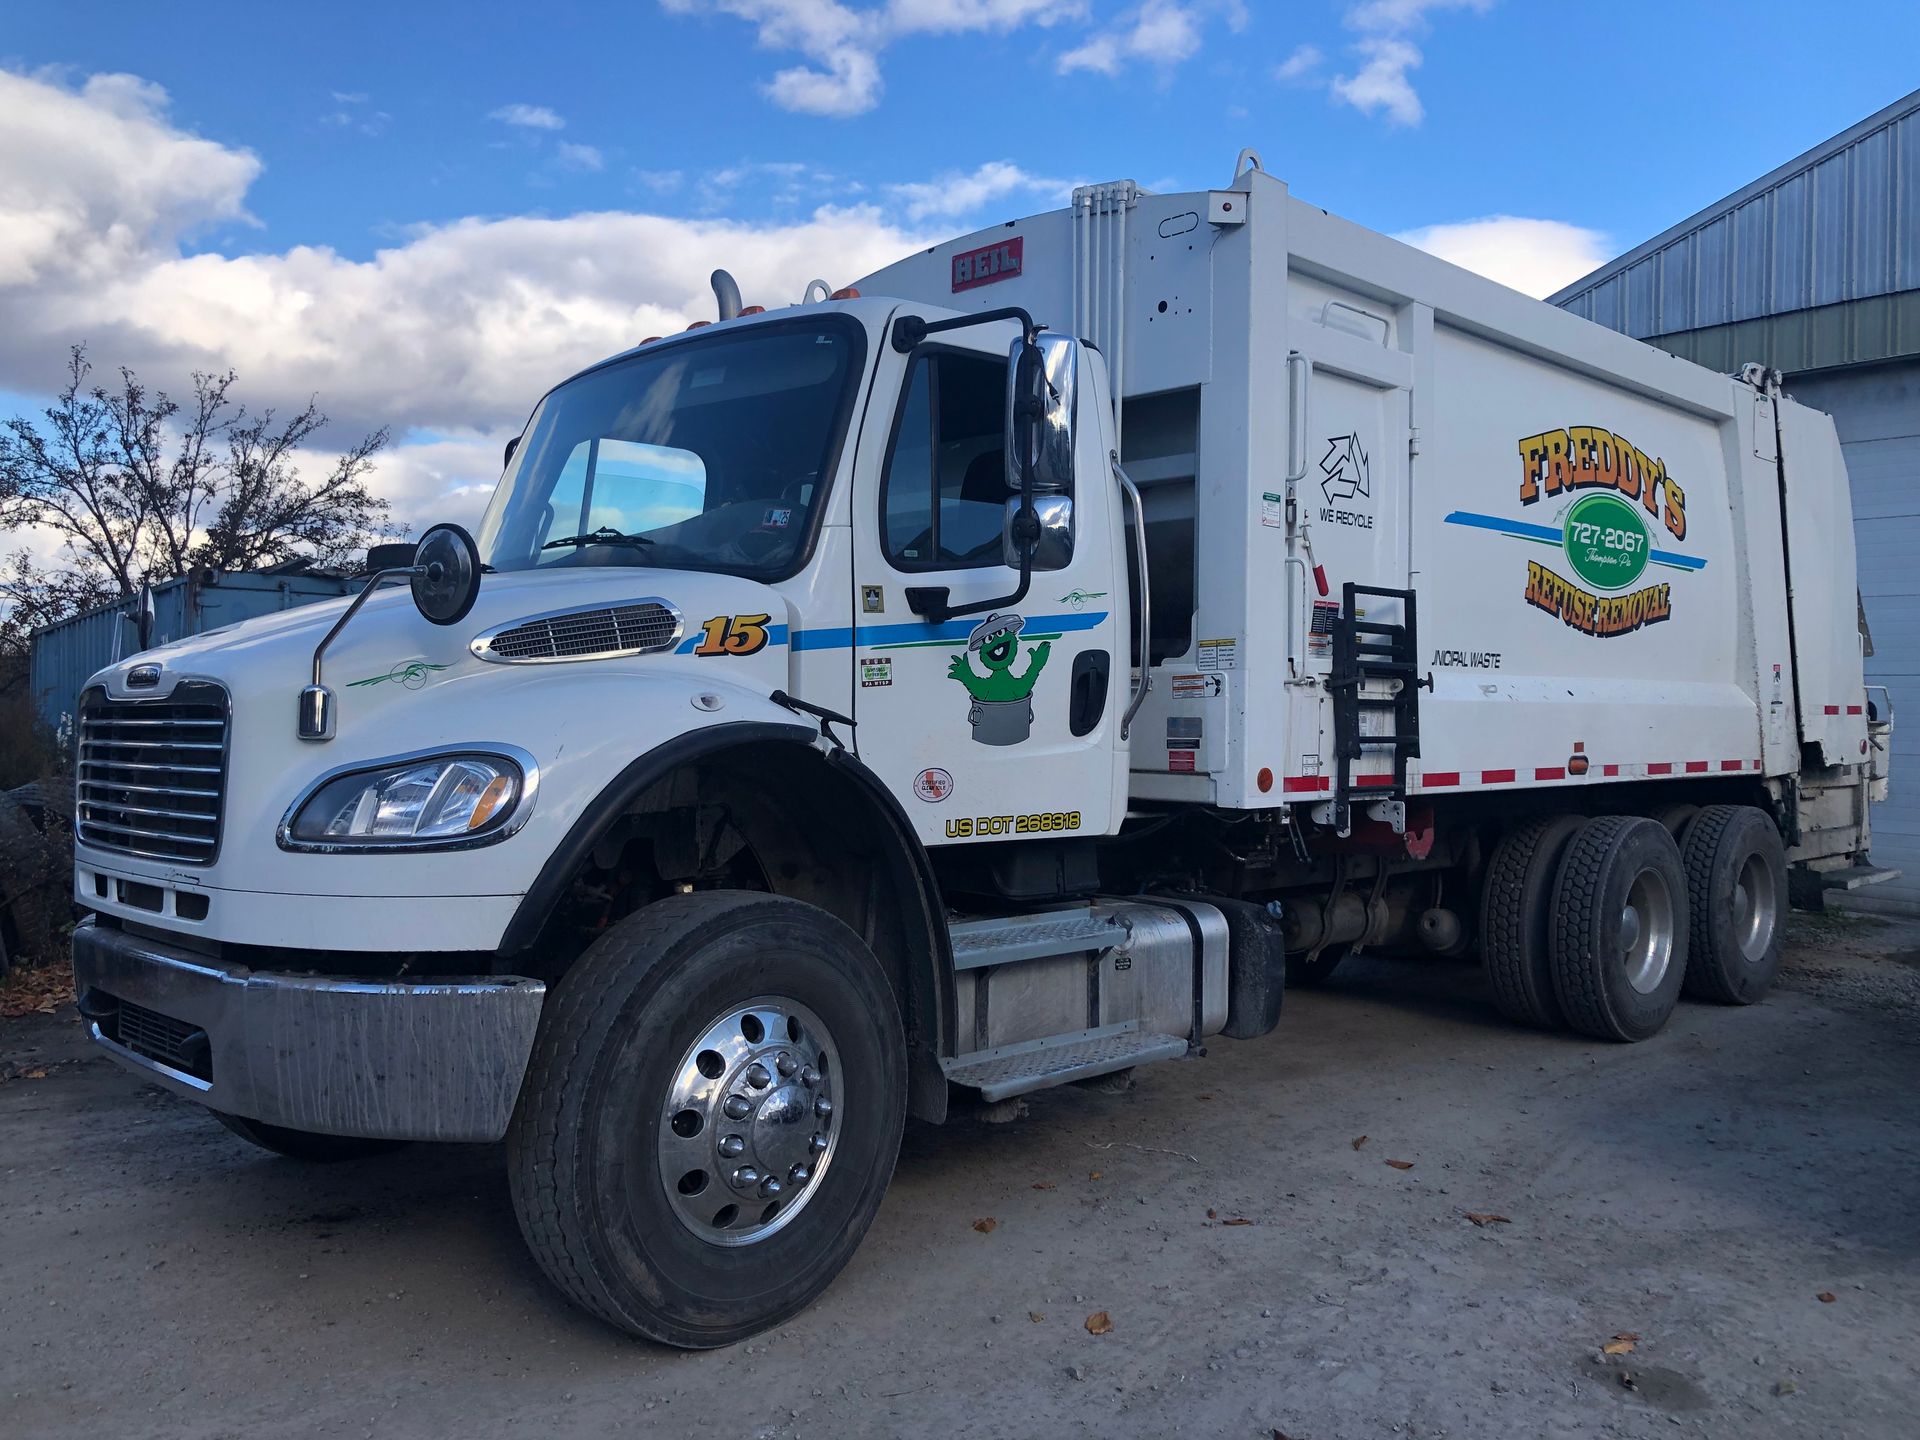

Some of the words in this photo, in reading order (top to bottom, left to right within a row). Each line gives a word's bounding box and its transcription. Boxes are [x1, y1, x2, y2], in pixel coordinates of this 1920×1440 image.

[955, 246, 1020, 284] HEIL
[1519, 426, 1686, 541] FREDDY'S
[1320, 508, 1335, 523] WE
[1336, 511, 1373, 529] RECYCLE
[1571, 521, 1644, 553] 727-2067
[1585, 547, 1618, 568] Thompson
[1525, 560, 1595, 637] REFUSE
[1597, 583, 1671, 638] REMOVAL
[695, 613, 772, 657] 15
[1471, 652, 1501, 669] WASTE
[945, 818, 973, 838] US
[976, 816, 1014, 836] DOT
[1015, 811, 1081, 833] 268318
